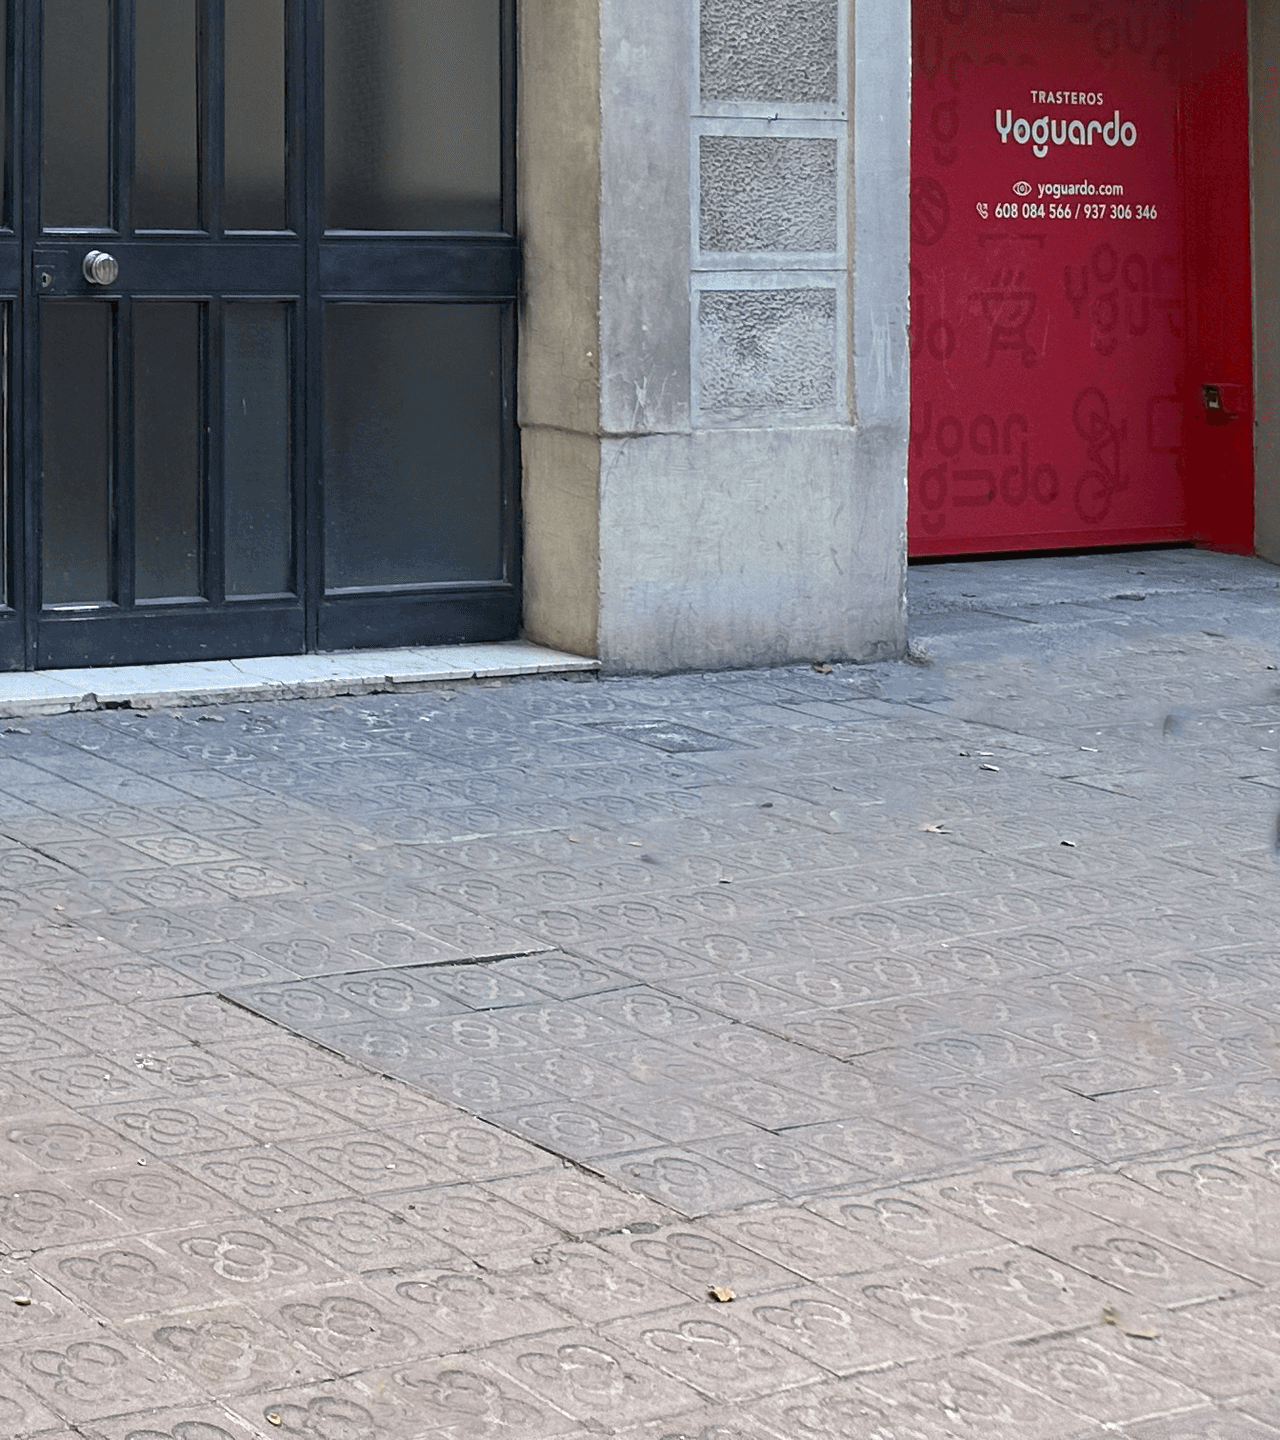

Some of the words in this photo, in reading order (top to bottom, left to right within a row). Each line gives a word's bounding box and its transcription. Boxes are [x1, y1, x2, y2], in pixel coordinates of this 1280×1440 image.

[1031, 91, 1103, 105] TRASTEROS
[995, 108, 1137, 158] Yoguardo
[1038, 180, 1123, 198] yoguardo.com
[995, 203, 1018, 218] 608
[1022, 203, 1045, 218] 084
[1049, 204, 1071, 218] 566
[1084, 204, 1106, 218] 937
[1110, 205, 1131, 219] 306
[1136, 205, 1157, 219] 346
